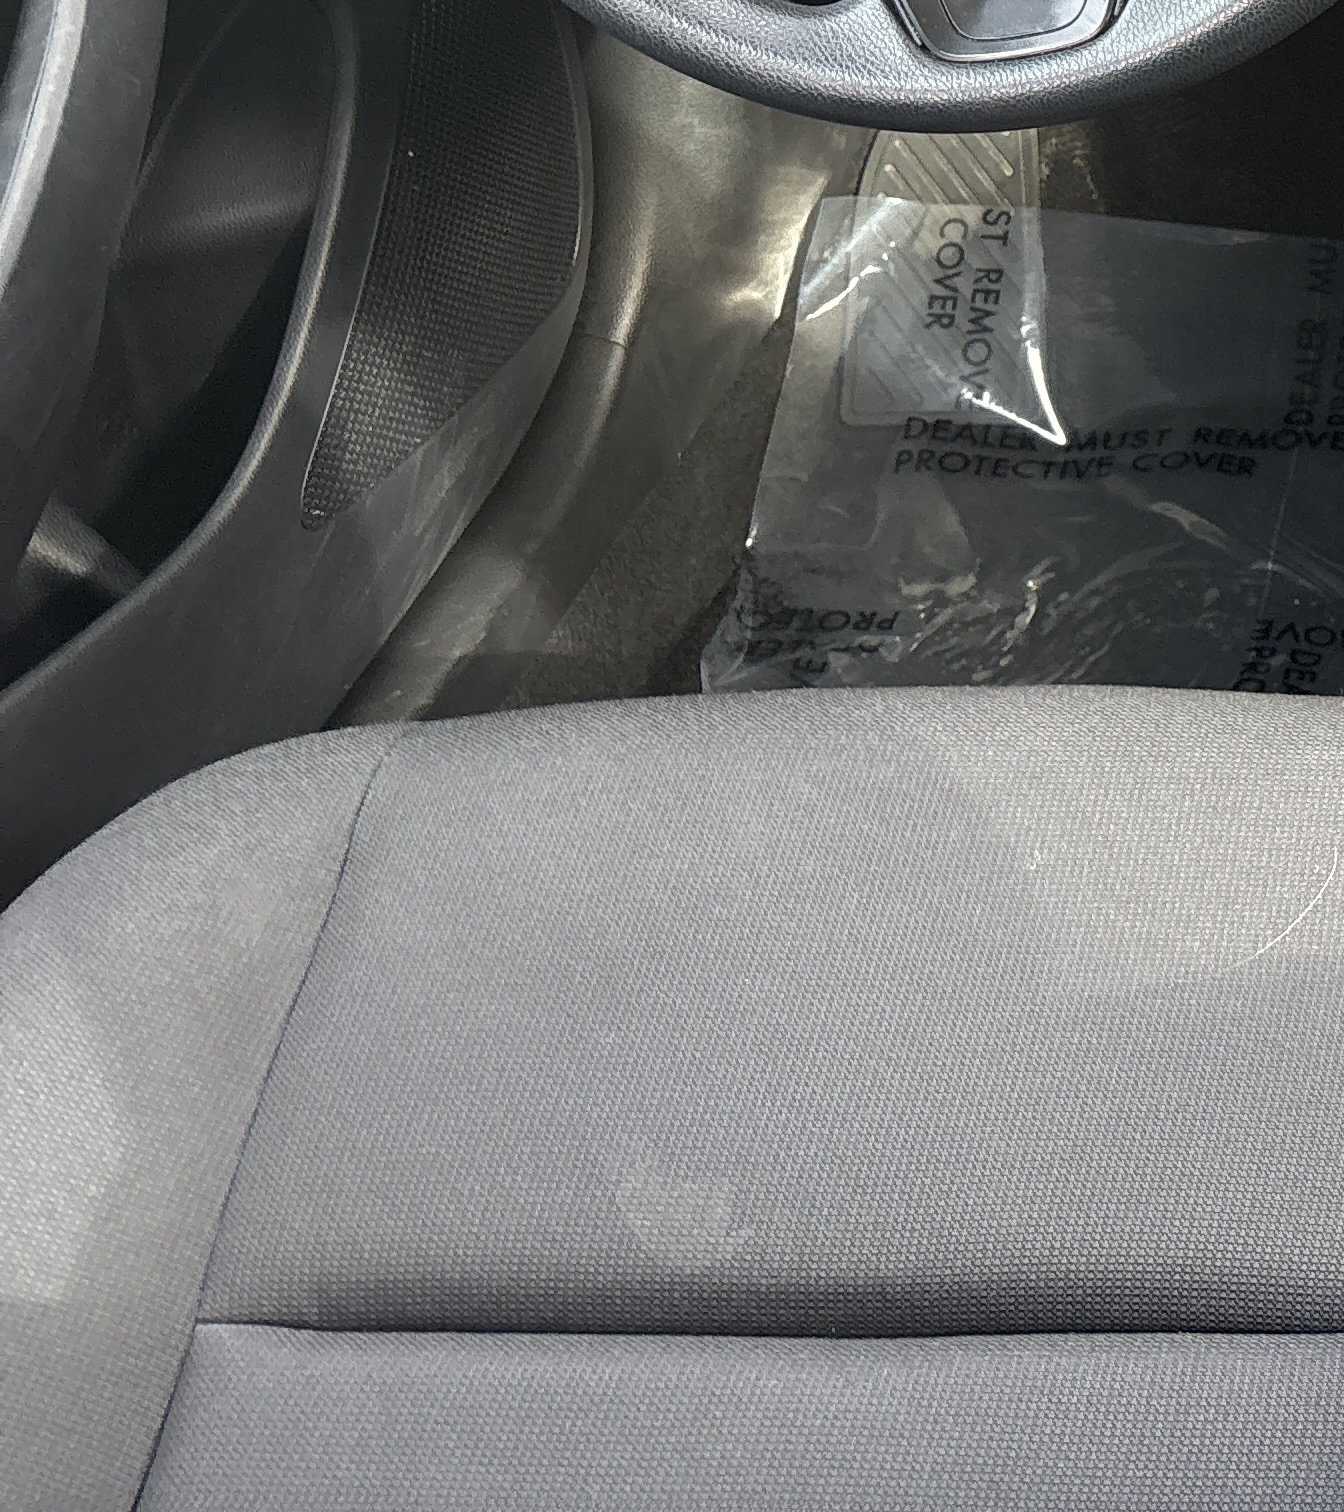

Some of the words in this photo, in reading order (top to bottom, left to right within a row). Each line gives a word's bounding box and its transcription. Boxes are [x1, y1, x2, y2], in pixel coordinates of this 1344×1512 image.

[924, 216, 970, 331] COVER
[903, 415, 1040, 453] DEALER
[1068, 427, 1173, 454] MUST
[893, 448, 1117, 481] PROTECTIVE
[1131, 451, 1257, 478] COVER
